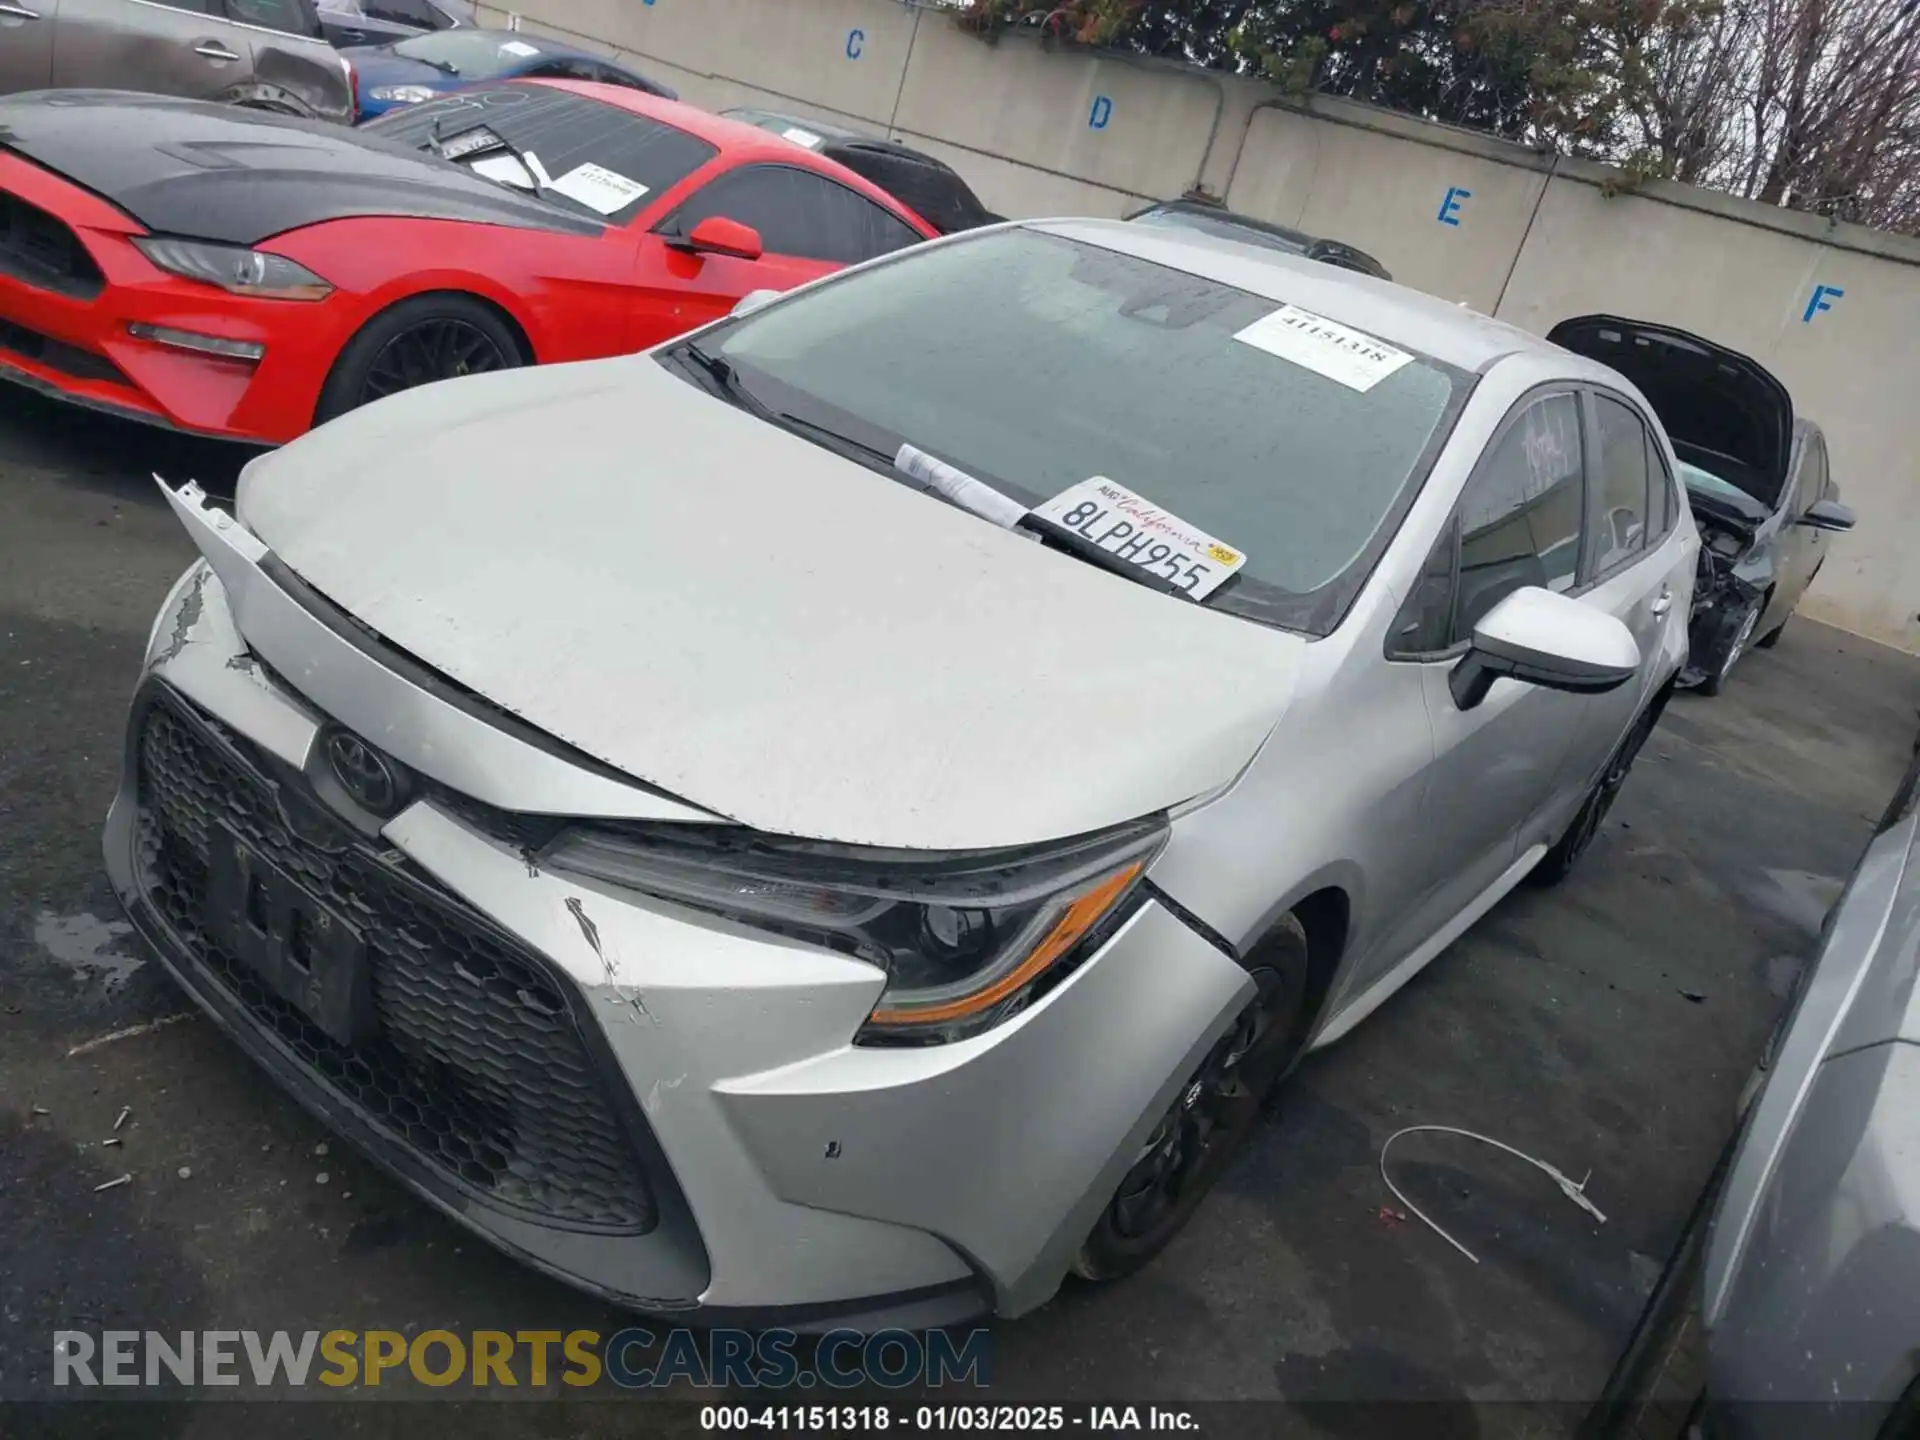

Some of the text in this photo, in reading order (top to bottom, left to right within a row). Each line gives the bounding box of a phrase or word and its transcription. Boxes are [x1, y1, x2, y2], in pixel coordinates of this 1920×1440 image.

[846, 29, 864, 60] C
[1089, 96, 1112, 129] D
[1437, 187, 1470, 226] E
[1803, 285, 1843, 322] F
[1282, 317, 1387, 362] 41151318
[1097, 485, 1208, 556] AUG California
[1061, 500, 1211, 592] 8LPH955
